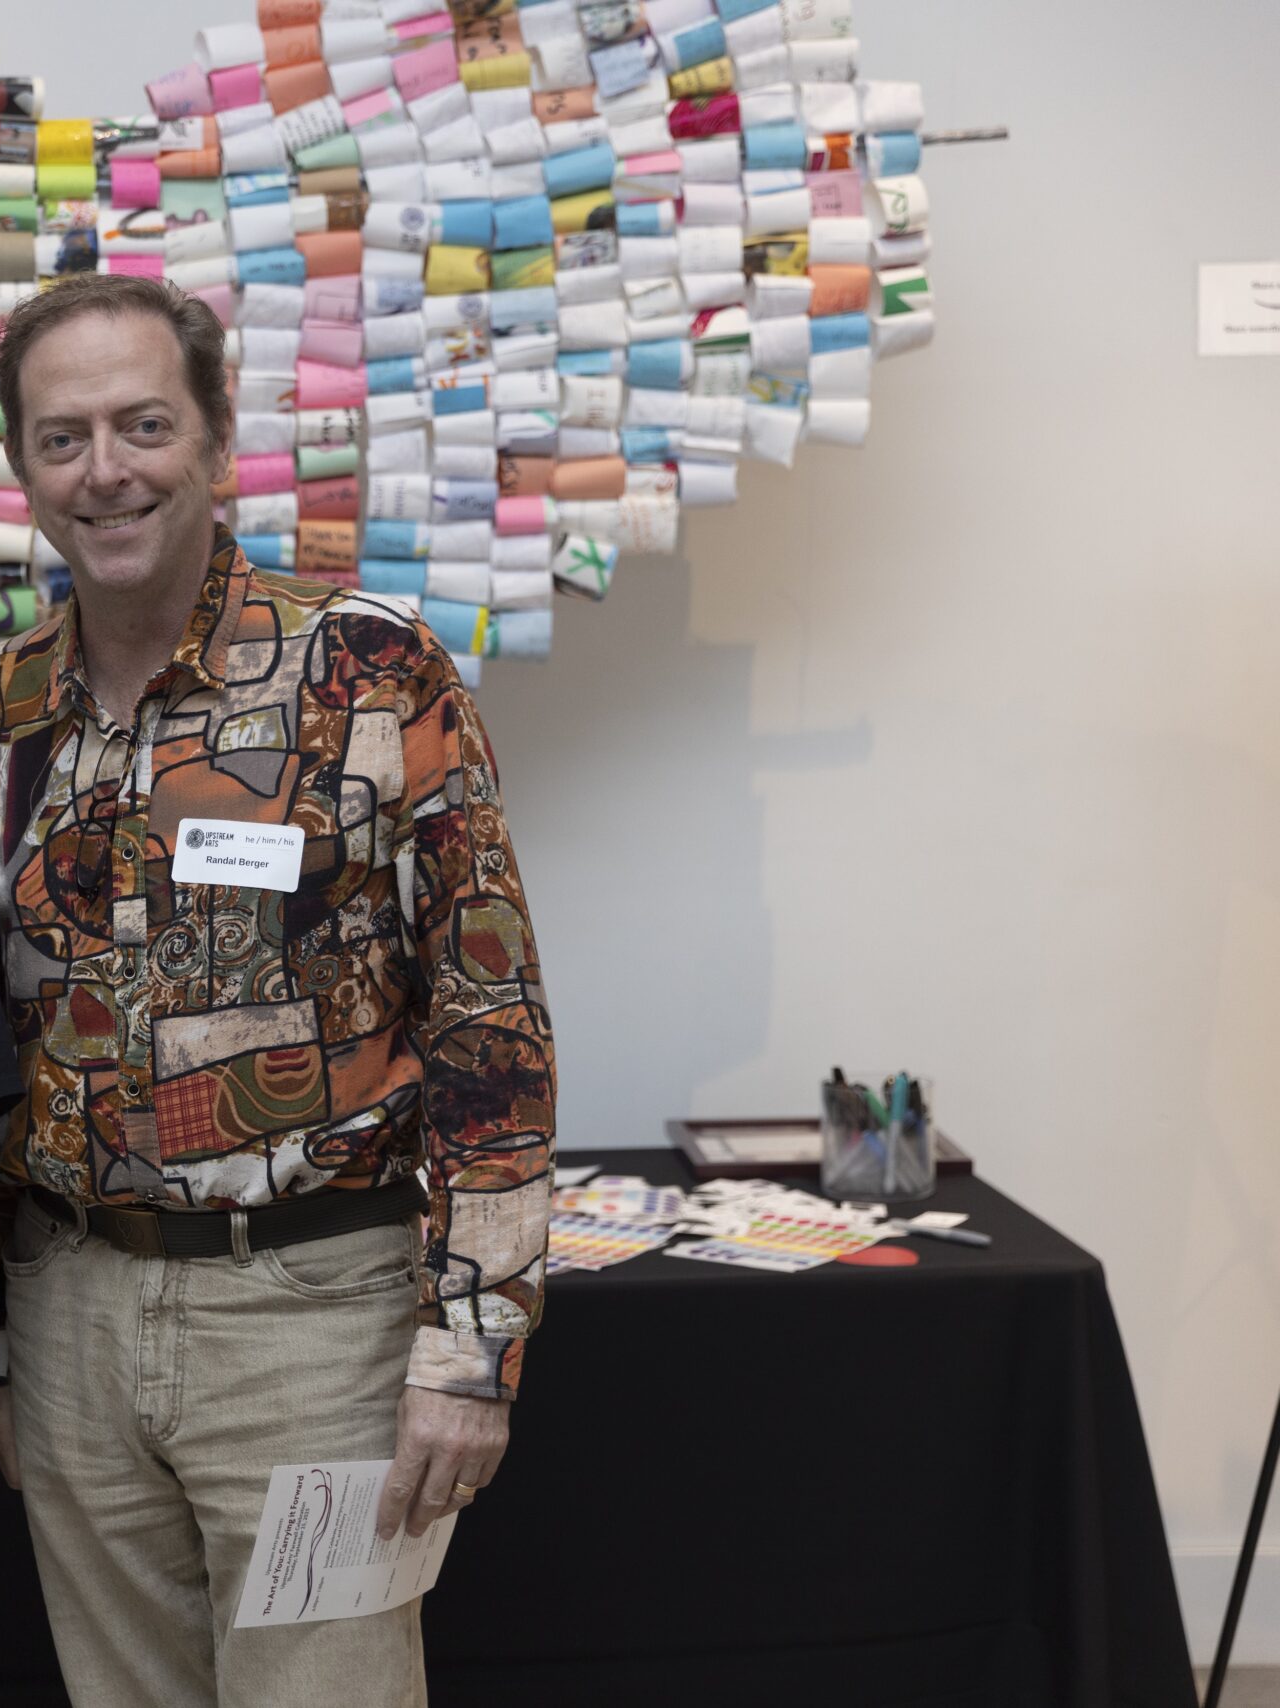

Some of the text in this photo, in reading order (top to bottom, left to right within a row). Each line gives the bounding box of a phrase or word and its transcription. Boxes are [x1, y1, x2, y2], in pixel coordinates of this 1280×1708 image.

[205, 831, 235, 841] UPSTREAM
[245, 835, 254, 844] he
[262, 836, 277, 844] him
[283, 837, 295, 846] his
[204, 840, 219, 848] ARTS
[205, 856, 270, 869] Randal Berger
[290, 1475, 303, 1509] Forward
[289, 1510, 296, 1519] it
[279, 1519, 295, 1553] Carrying
[274, 1556, 284, 1572] You:
[273, 1575, 278, 1583] of
[262, 1600, 272, 1616] The
